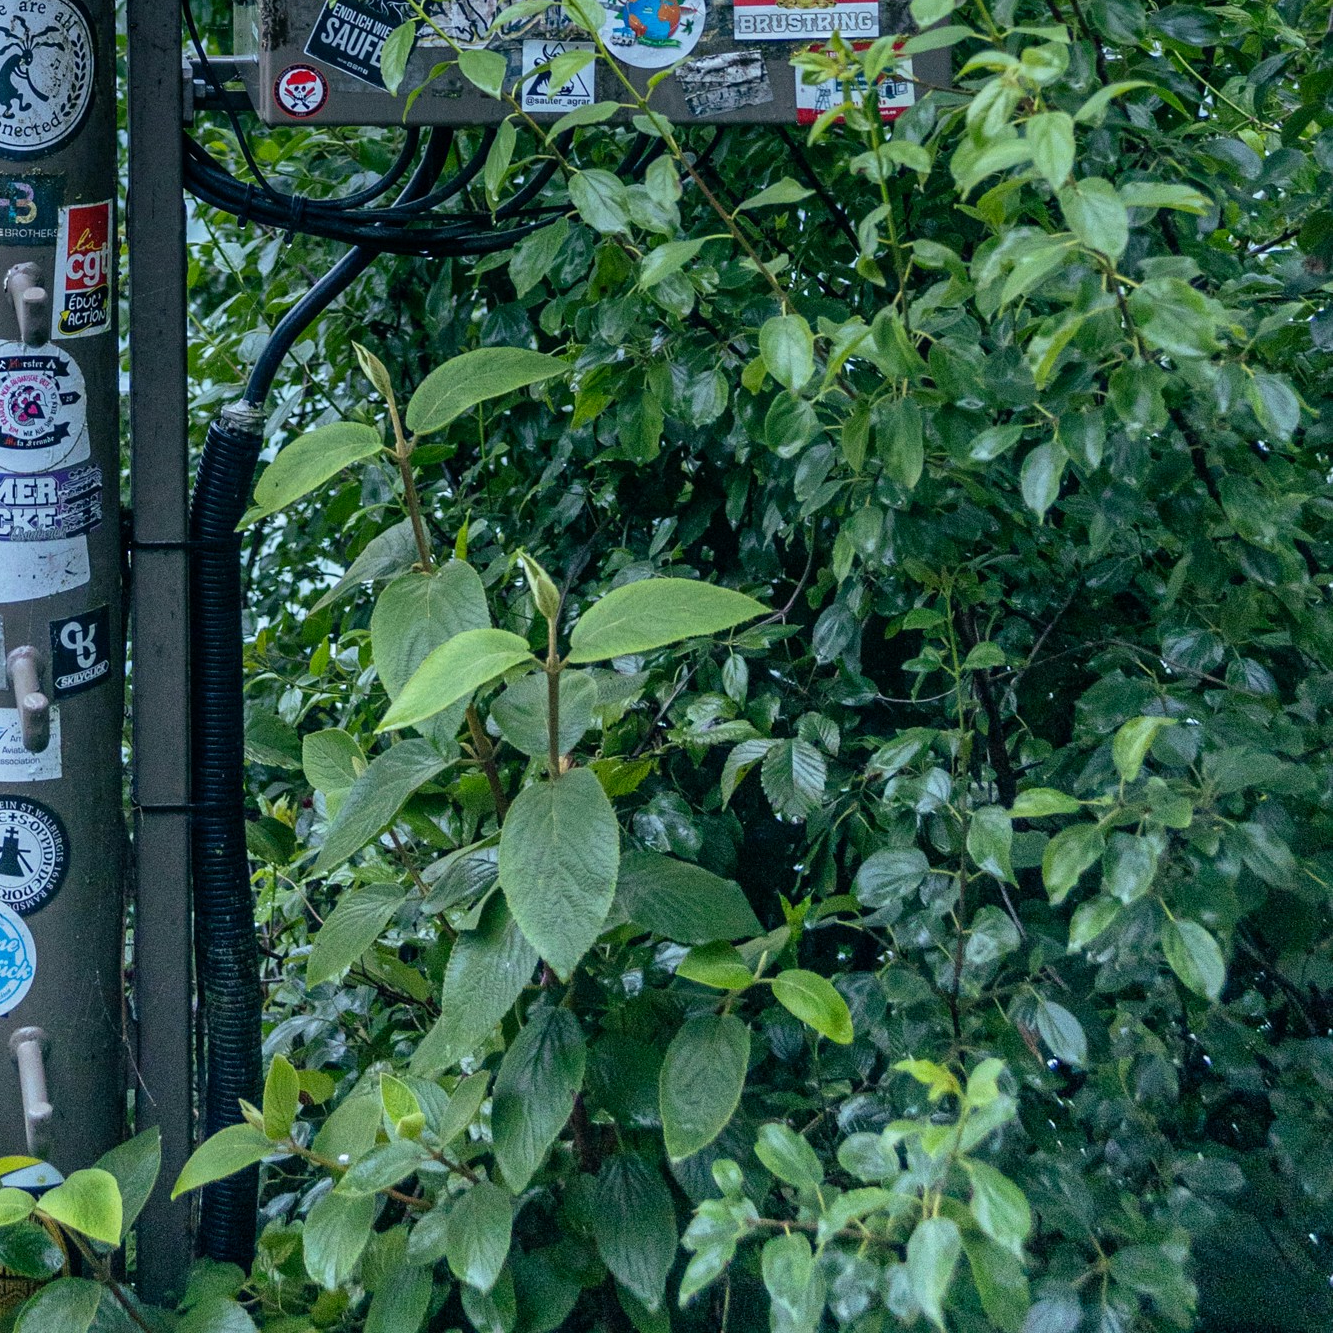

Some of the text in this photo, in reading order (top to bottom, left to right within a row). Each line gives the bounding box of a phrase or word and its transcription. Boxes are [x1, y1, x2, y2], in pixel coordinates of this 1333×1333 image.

[19, 0, 46, 15] are
[55, 8, 78, 32] all
[332, 3, 373, 32] ENDLICH
[739, 12, 874, 34] BRUSTRING
[525, 96, 590, 107] @sauter_agrar
[66, 242, 113, 286] cgt
[45, 867, 62, 890] 1618
